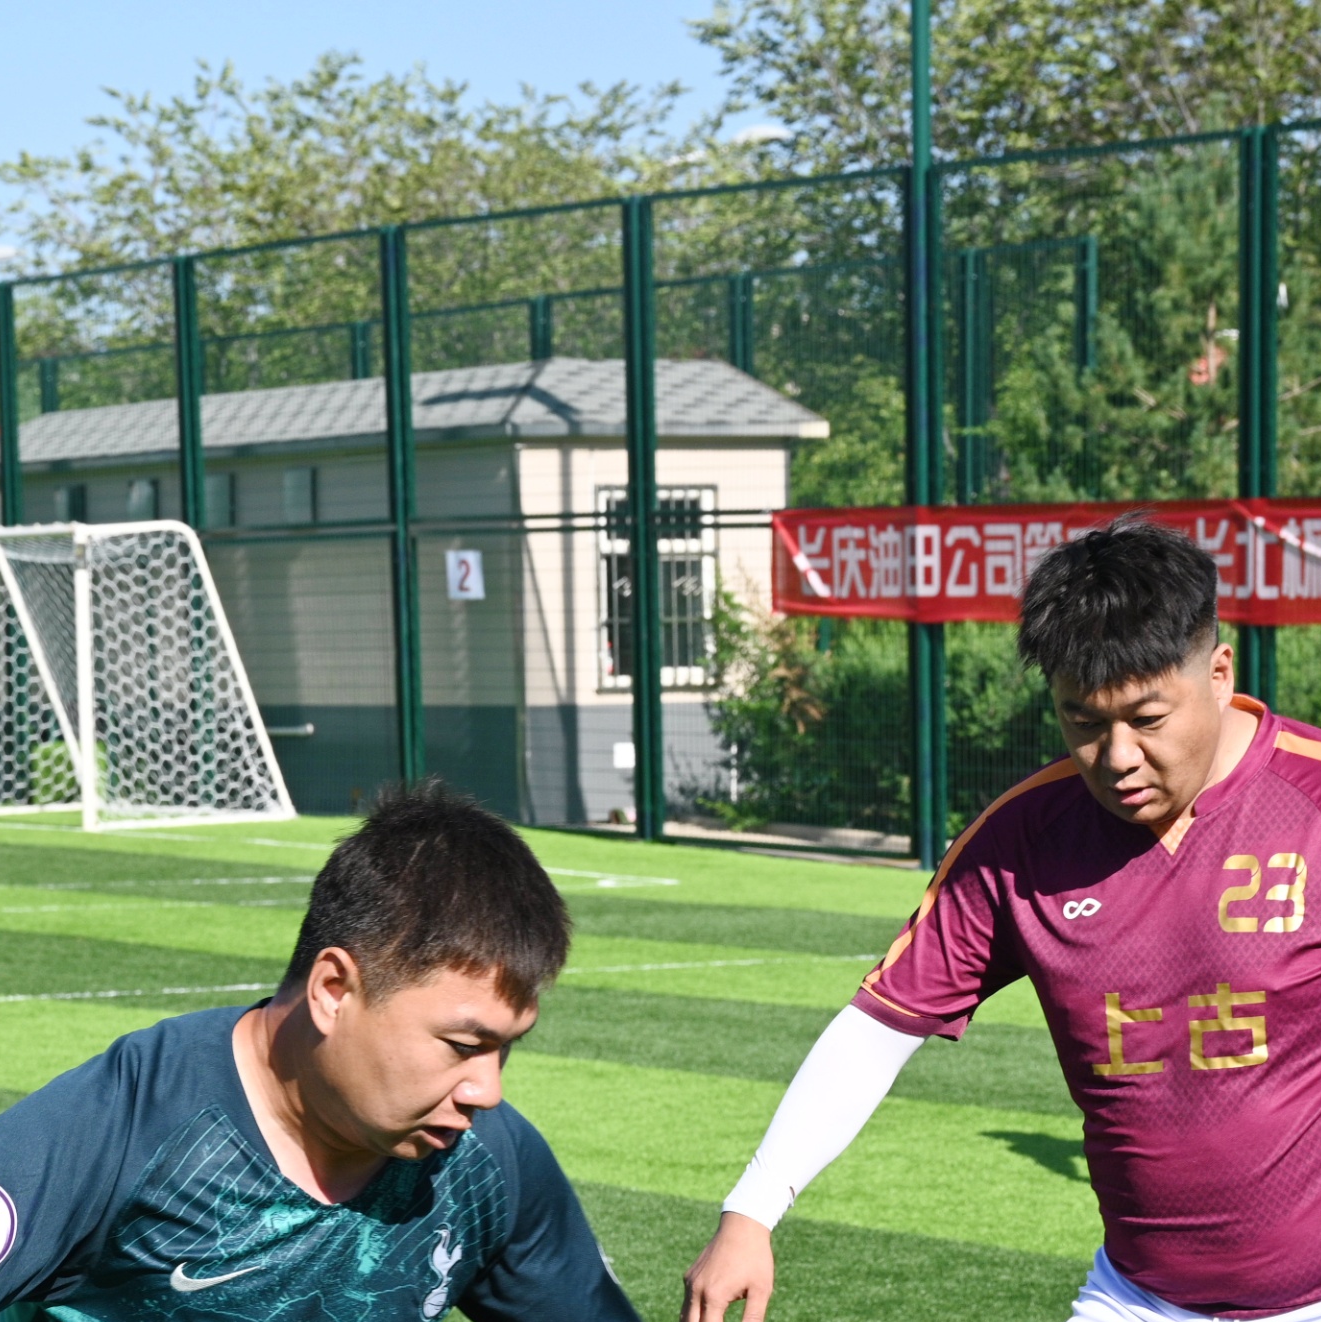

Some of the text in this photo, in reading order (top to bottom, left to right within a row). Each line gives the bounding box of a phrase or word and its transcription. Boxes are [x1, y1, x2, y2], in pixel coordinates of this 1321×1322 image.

[457, 558, 471, 593] 2
[1217, 852, 1308, 934] 23
[1091, 982, 1269, 1076] 上古
